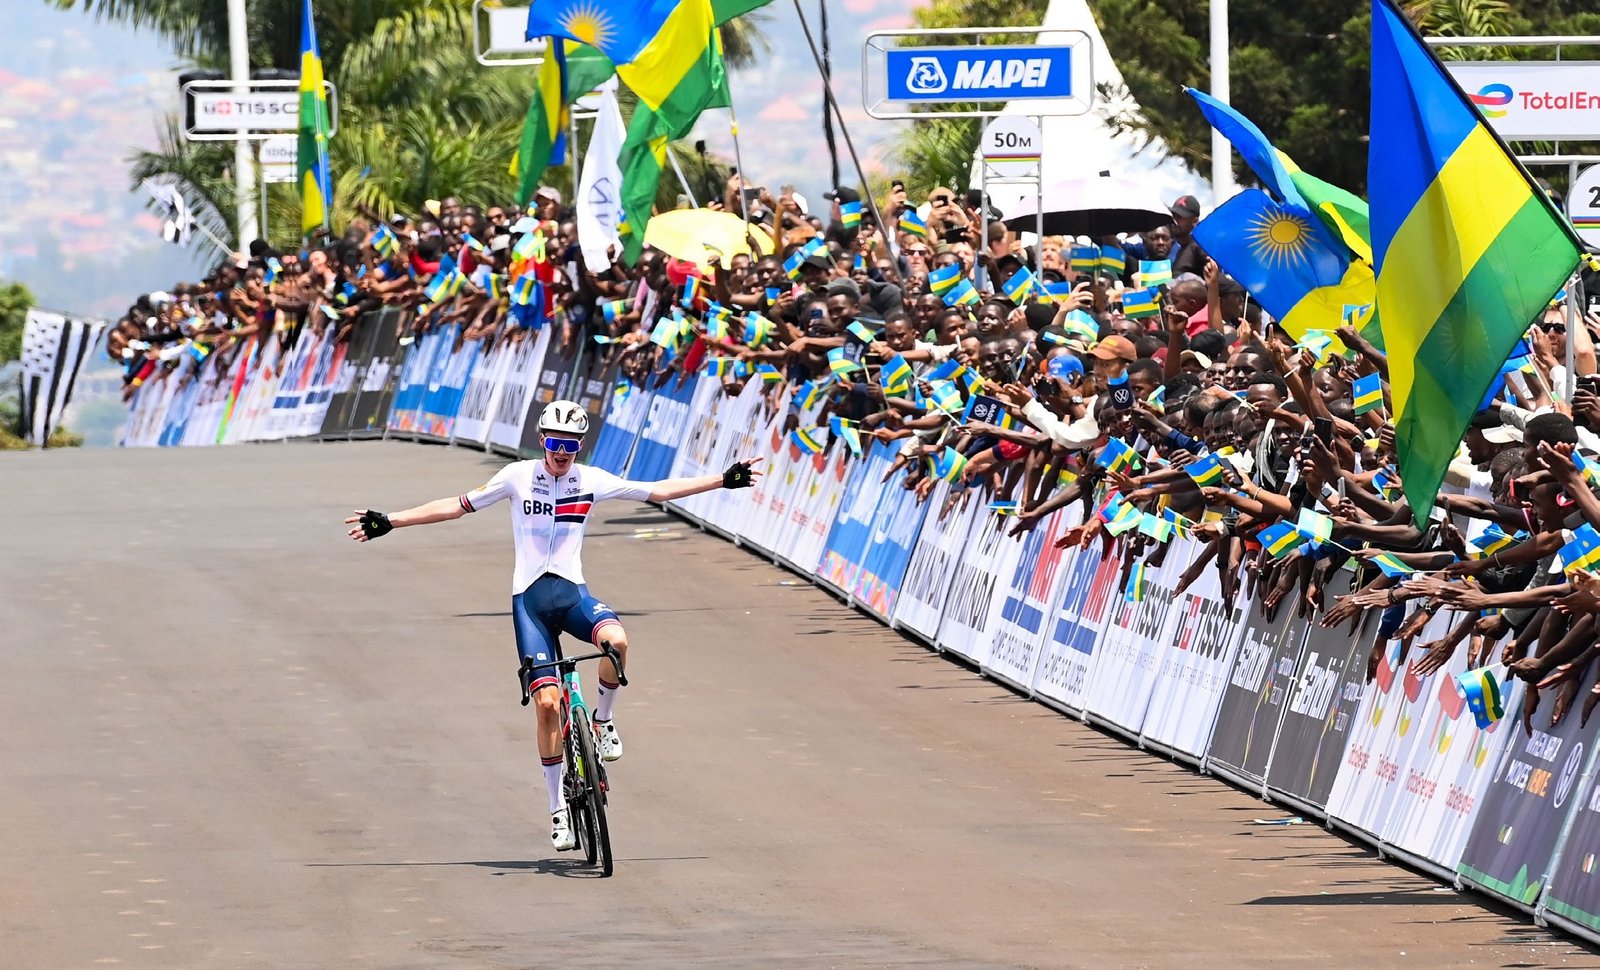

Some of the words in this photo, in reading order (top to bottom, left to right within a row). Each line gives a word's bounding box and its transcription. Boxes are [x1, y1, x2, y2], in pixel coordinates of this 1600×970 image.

[952, 58, 1051, 90] MAPEI
[236, 101, 299, 115] TISSO
[1519, 92, 1600, 110] TotalEn
[523, 499, 554, 516] GBR
[1191, 597, 1241, 663] TISSOT
[1231, 627, 1277, 694] Santini
[1290, 651, 1344, 720] Santini
